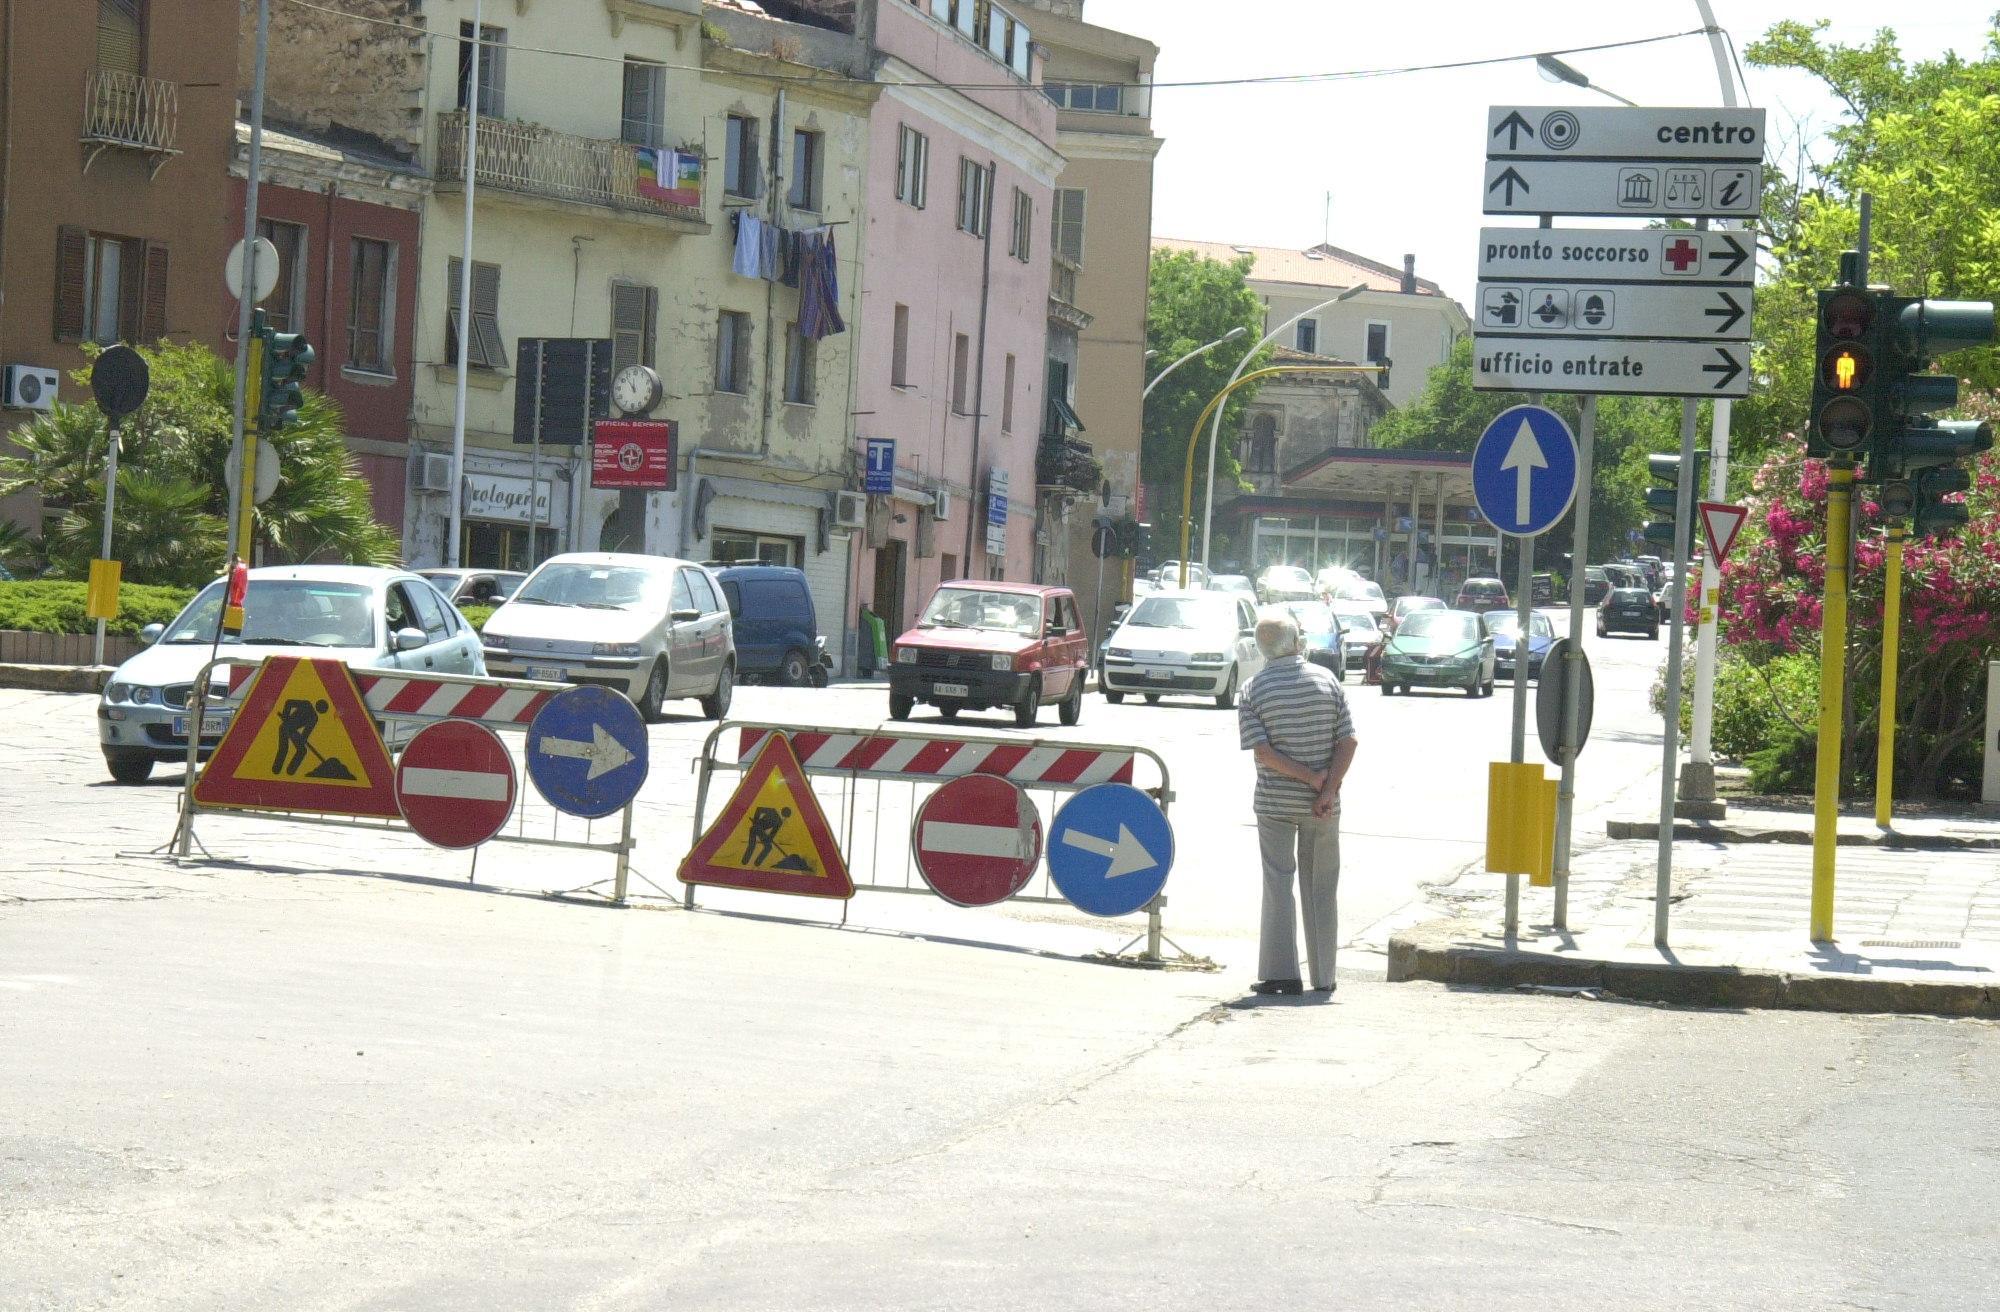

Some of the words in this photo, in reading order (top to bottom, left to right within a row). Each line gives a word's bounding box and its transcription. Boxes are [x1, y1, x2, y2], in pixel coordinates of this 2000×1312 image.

[1657, 121, 1756, 144] centro
[1673, 174, 1699, 182] LEX
[1486, 240, 1553, 263] pronto
[1561, 246, 1650, 262] soccorso
[1480, 352, 1553, 374] ufficio
[1562, 354, 1644, 376] entrate
[868, 441, 893, 471] T
[471, 483, 548, 510] rologera
